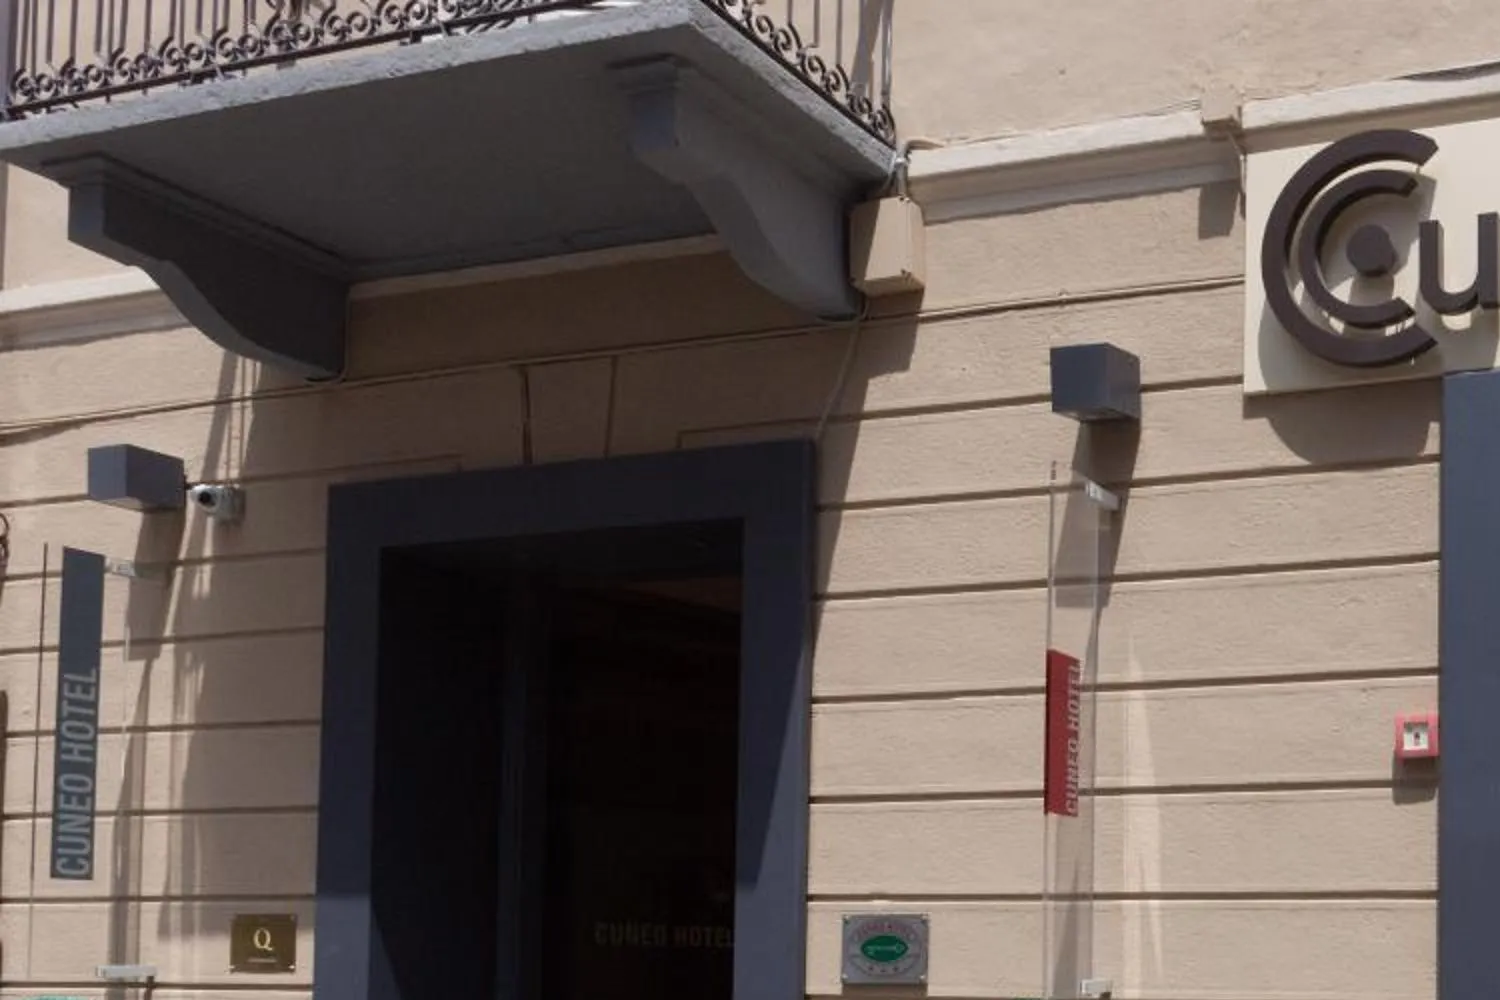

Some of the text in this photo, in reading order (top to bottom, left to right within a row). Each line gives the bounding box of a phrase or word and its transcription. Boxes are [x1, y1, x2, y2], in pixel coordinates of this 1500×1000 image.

[56, 668, 97, 875] CUNEO HOTEL
[253, 927, 273, 951] Q
[594, 921, 668, 947] CUNEO
